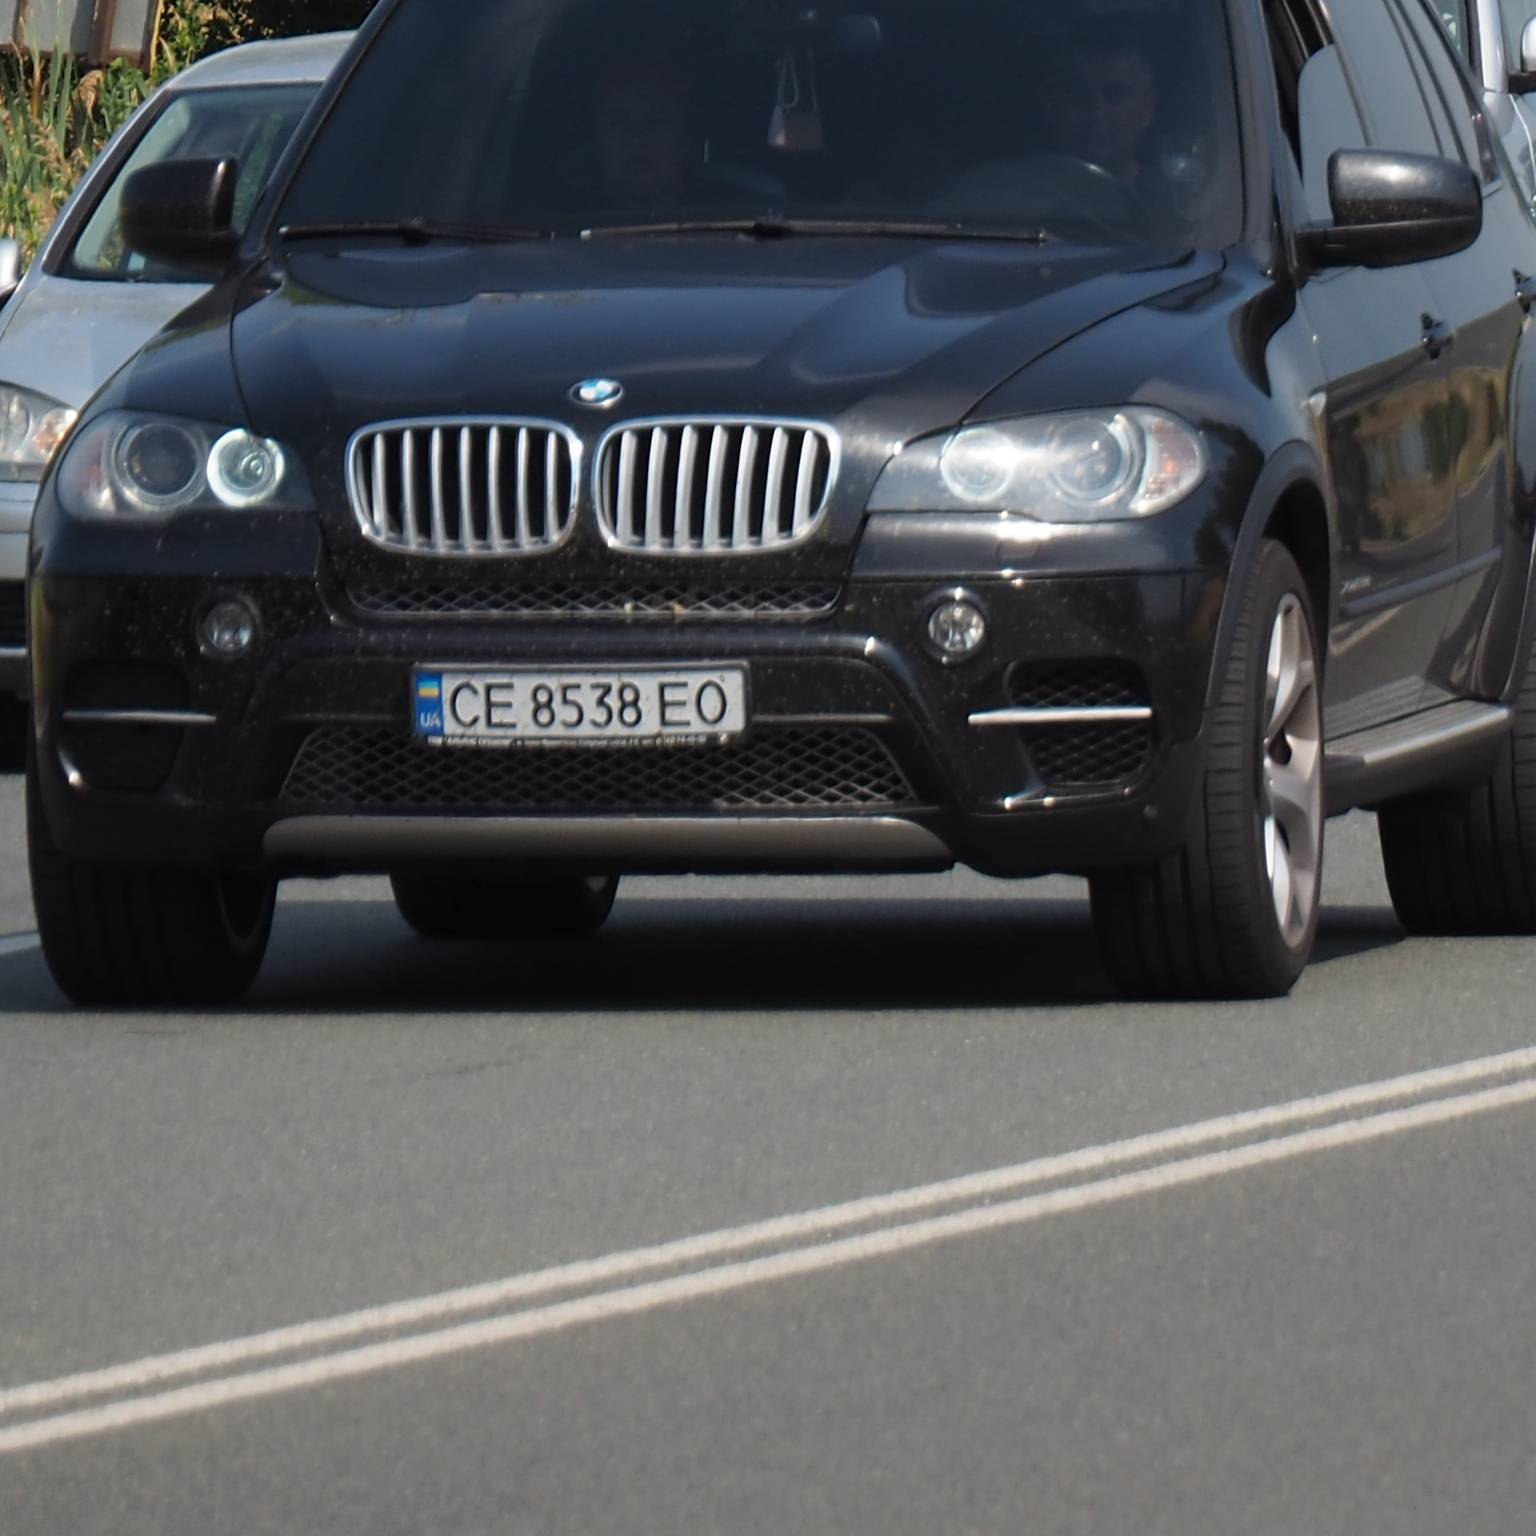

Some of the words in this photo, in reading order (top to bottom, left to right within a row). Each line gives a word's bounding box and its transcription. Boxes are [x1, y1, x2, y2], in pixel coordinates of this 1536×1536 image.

[420, 715, 441, 729] UA
[450, 681, 517, 729] CE
[531, 681, 643, 729] 8538
[657, 678, 728, 727] EO
